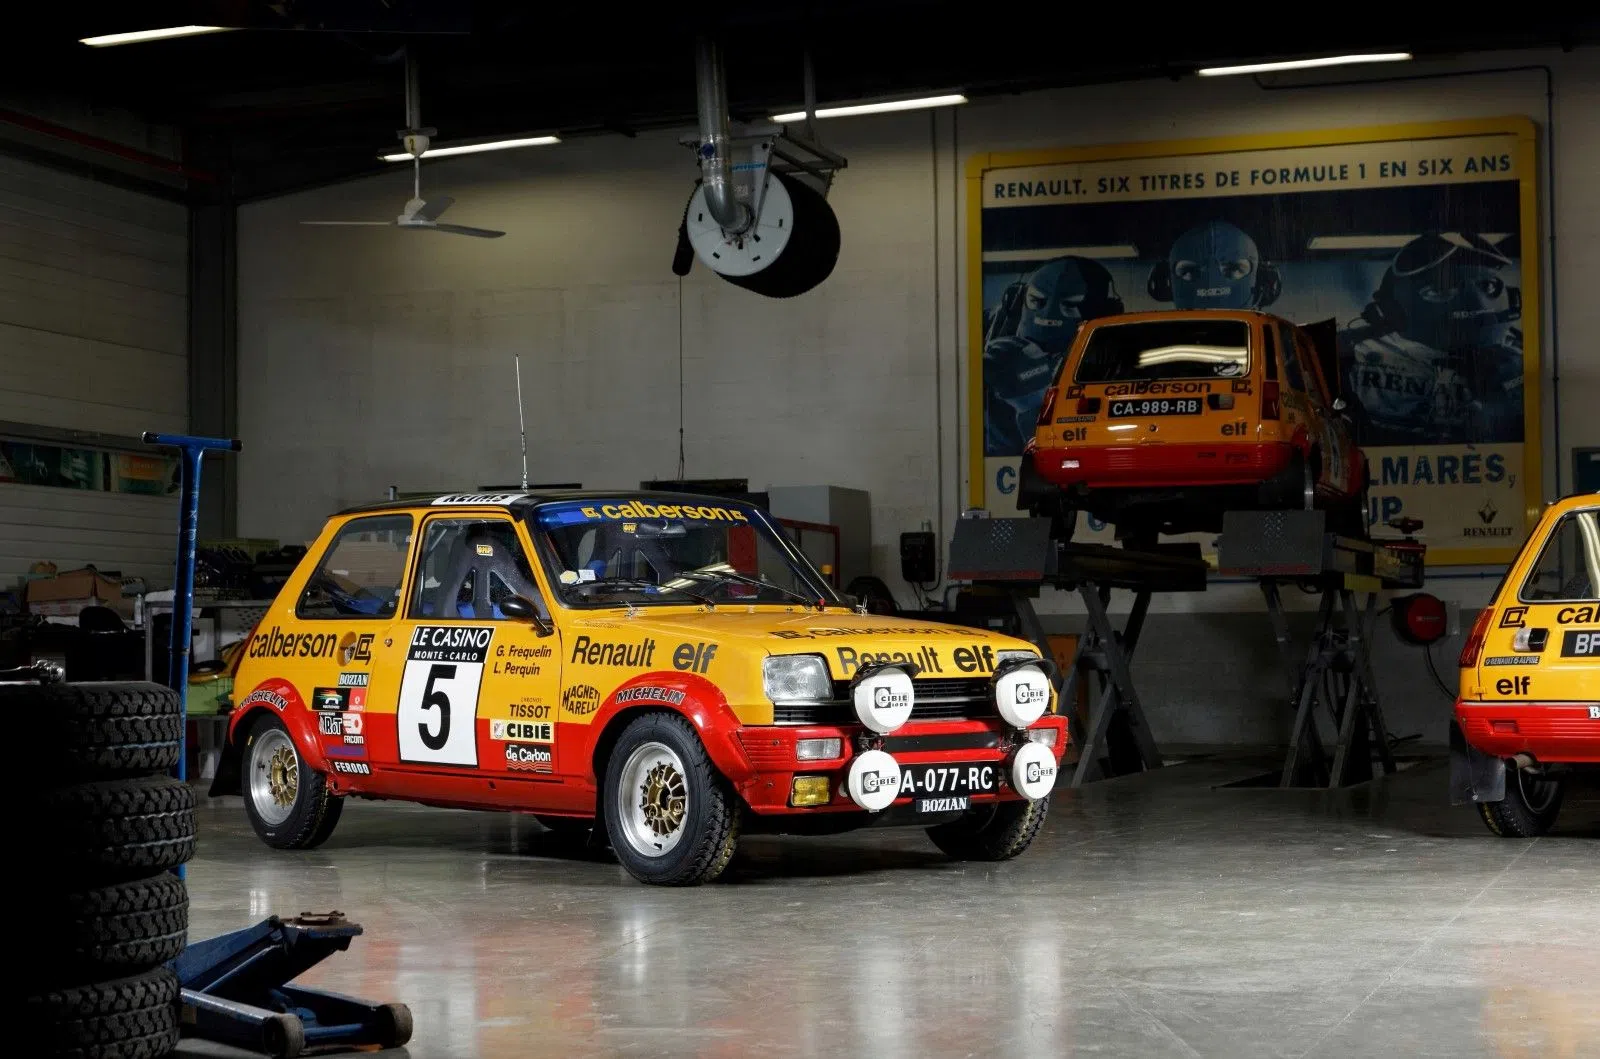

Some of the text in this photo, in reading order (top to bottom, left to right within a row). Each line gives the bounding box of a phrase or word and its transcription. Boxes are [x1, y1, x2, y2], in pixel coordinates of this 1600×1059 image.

[994, 154, 1511, 199] RENAULT. SIX TITRES DE FORMULE 1 EN SIX ANS
[1104, 380, 1211, 397] calberson
[1112, 398, 1200, 416] CA-989-RB
[1062, 427, 1088, 442] elf
[1220, 421, 1248, 437] elf
[601, 500, 734, 522] calberson
[1463, 527, 1514, 537] RENAULT
[249, 626, 338, 658] calberson
[412, 628, 490, 648] LE CASINO
[414, 650, 478, 661] MONTE CARLO
[496, 645, 552, 661] G. Fréquelin
[570, 636, 719, 674] Renault elf
[953, 644, 996, 673] elf
[493, 662, 540, 678] L. Perquin
[1496, 676, 1531, 696] elf
[240, 690, 289, 712] MICHELIN
[616, 686, 686, 706] MICHELIN
[418, 664, 458, 750] 5
[510, 704, 552, 719] TISSOT
[506, 747, 552, 763] de Carbon
[334, 762, 370, 774] FERODO
[922, 798, 968, 812] BOZIAN
